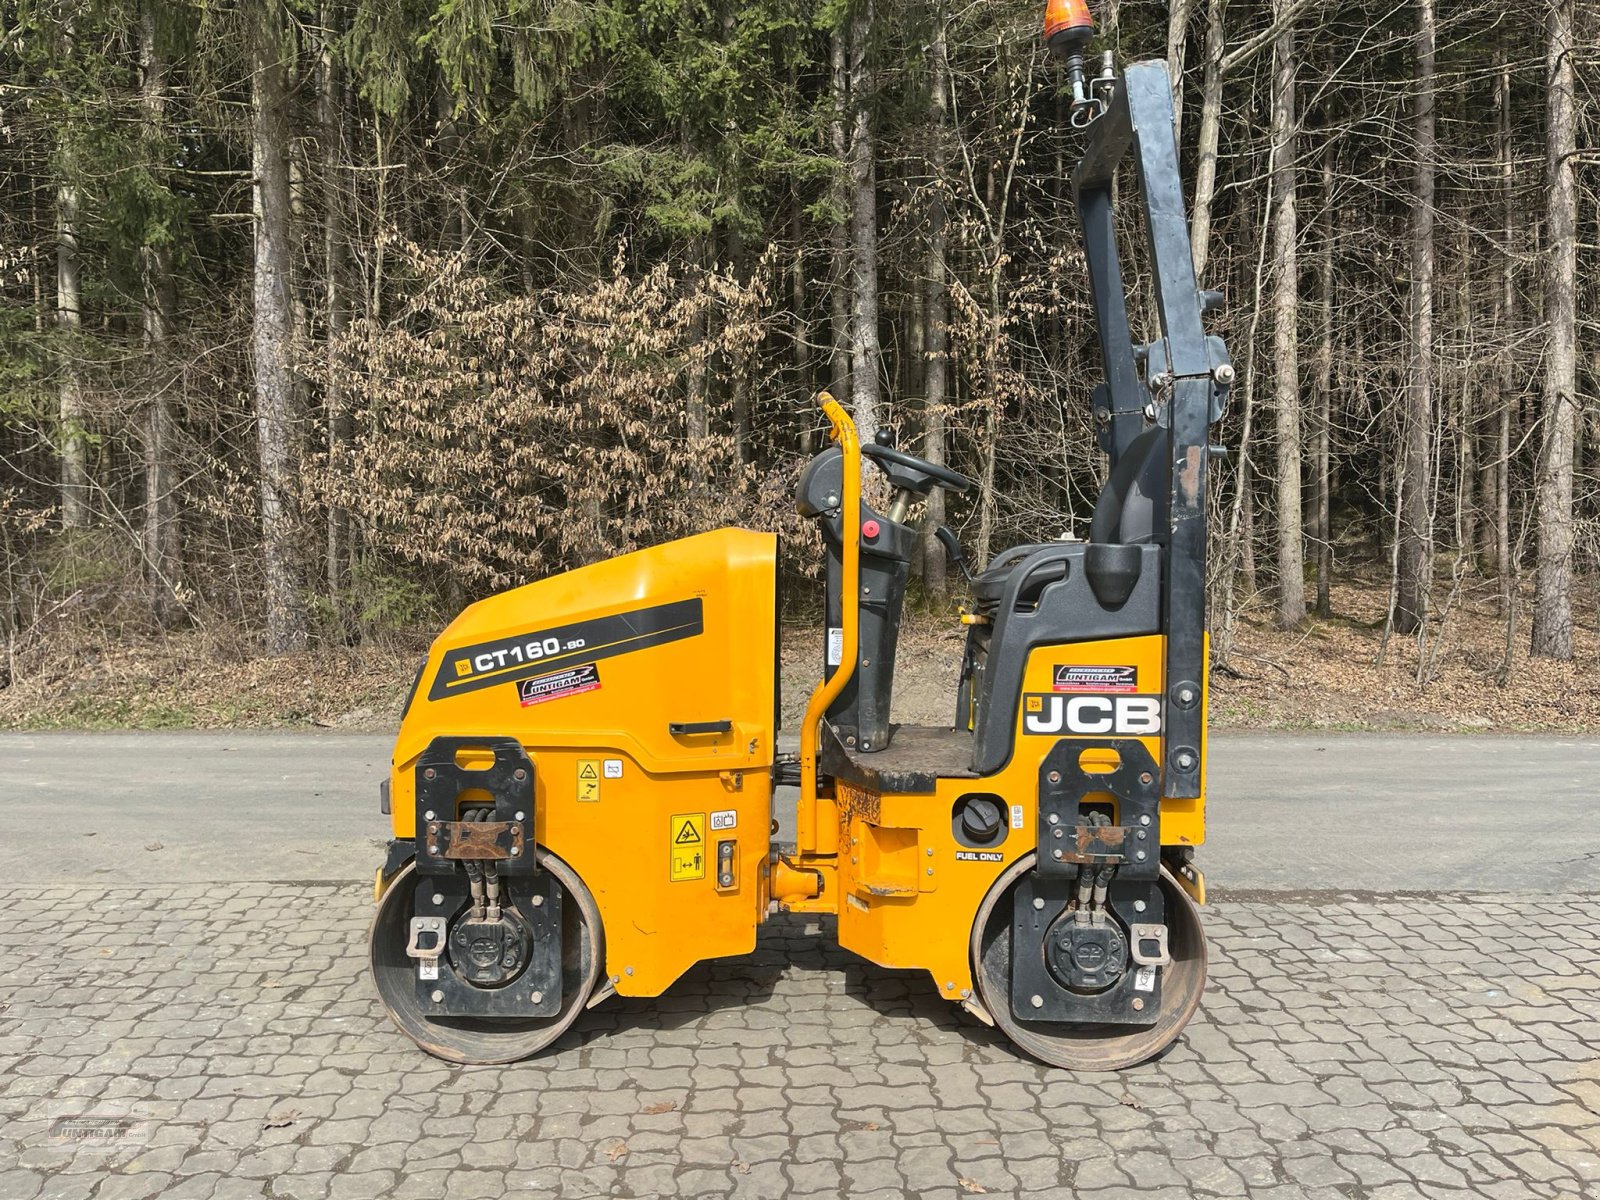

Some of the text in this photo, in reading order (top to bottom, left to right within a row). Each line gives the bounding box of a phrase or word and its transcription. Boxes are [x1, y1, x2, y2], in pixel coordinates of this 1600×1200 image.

[1027, 697, 1161, 734] JCB
[956, 852, 1003, 861] FUEL ONLY
